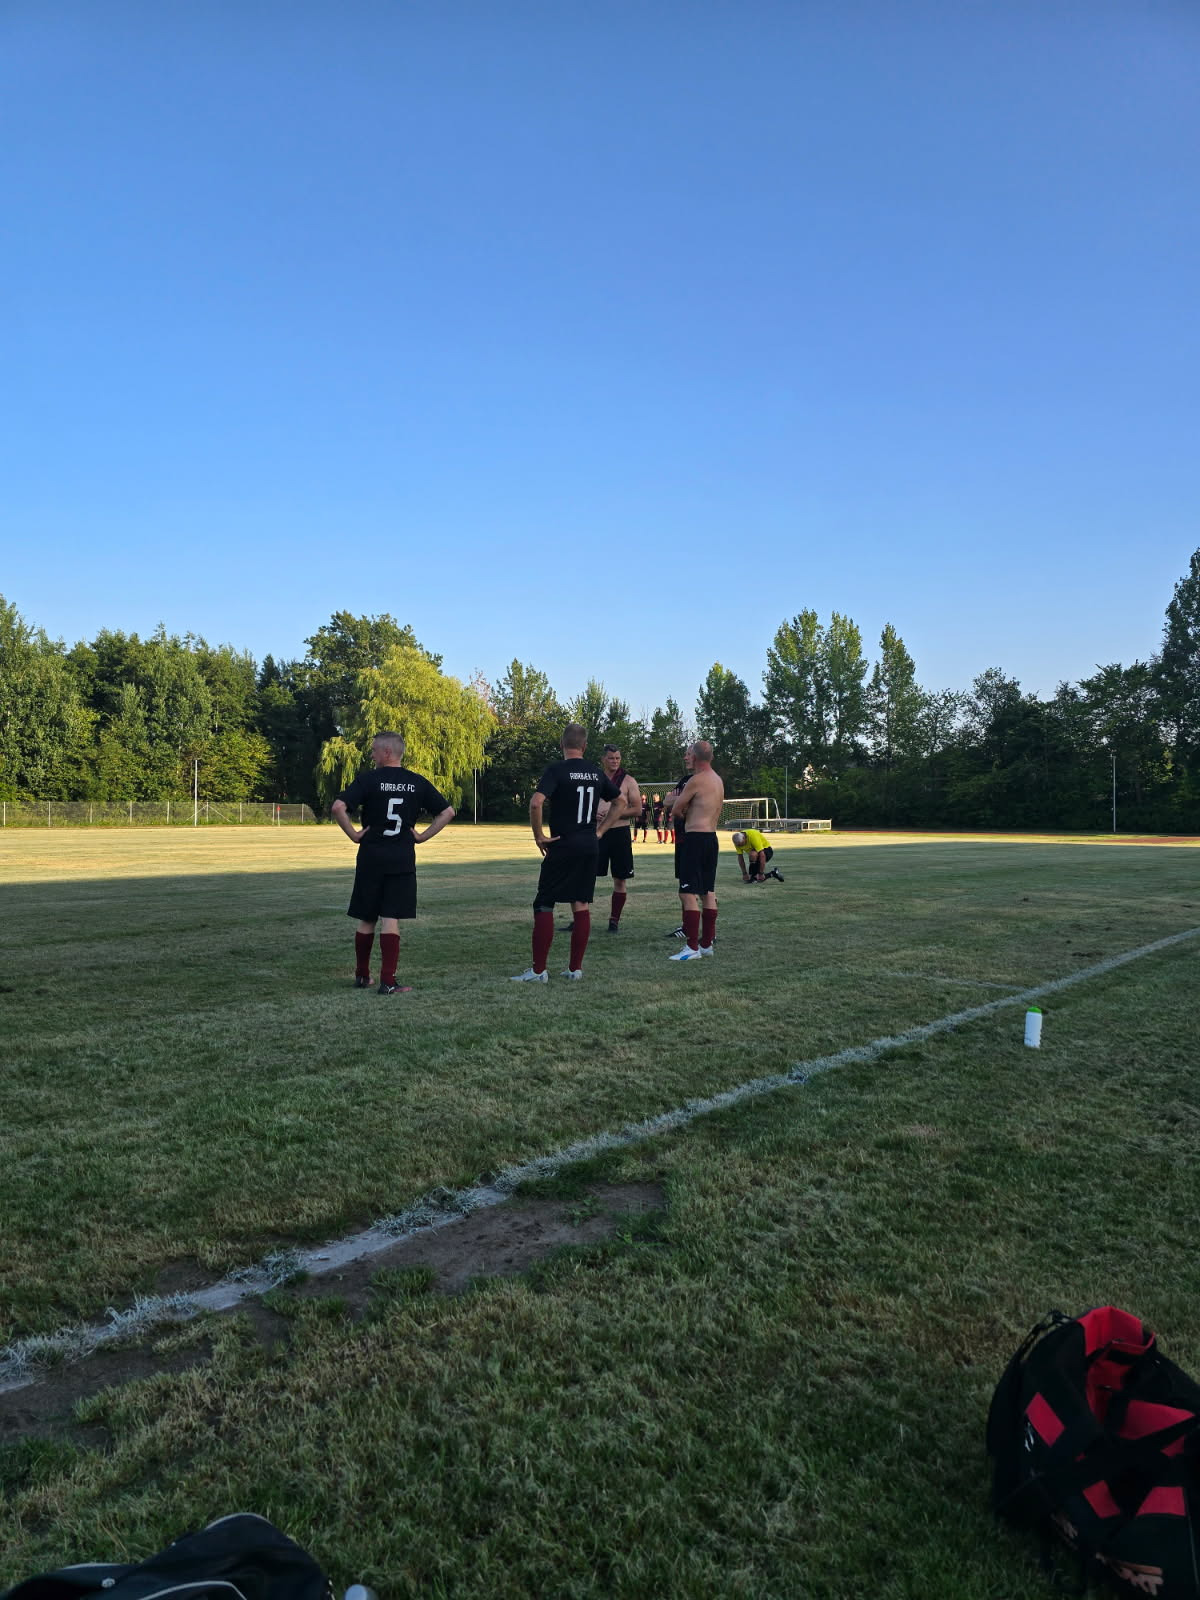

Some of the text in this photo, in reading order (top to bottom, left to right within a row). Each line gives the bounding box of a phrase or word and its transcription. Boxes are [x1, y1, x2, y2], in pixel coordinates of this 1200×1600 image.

[407, 783, 416, 793] FC
[576, 786, 594, 824] 11
[383, 798, 404, 837] 5
